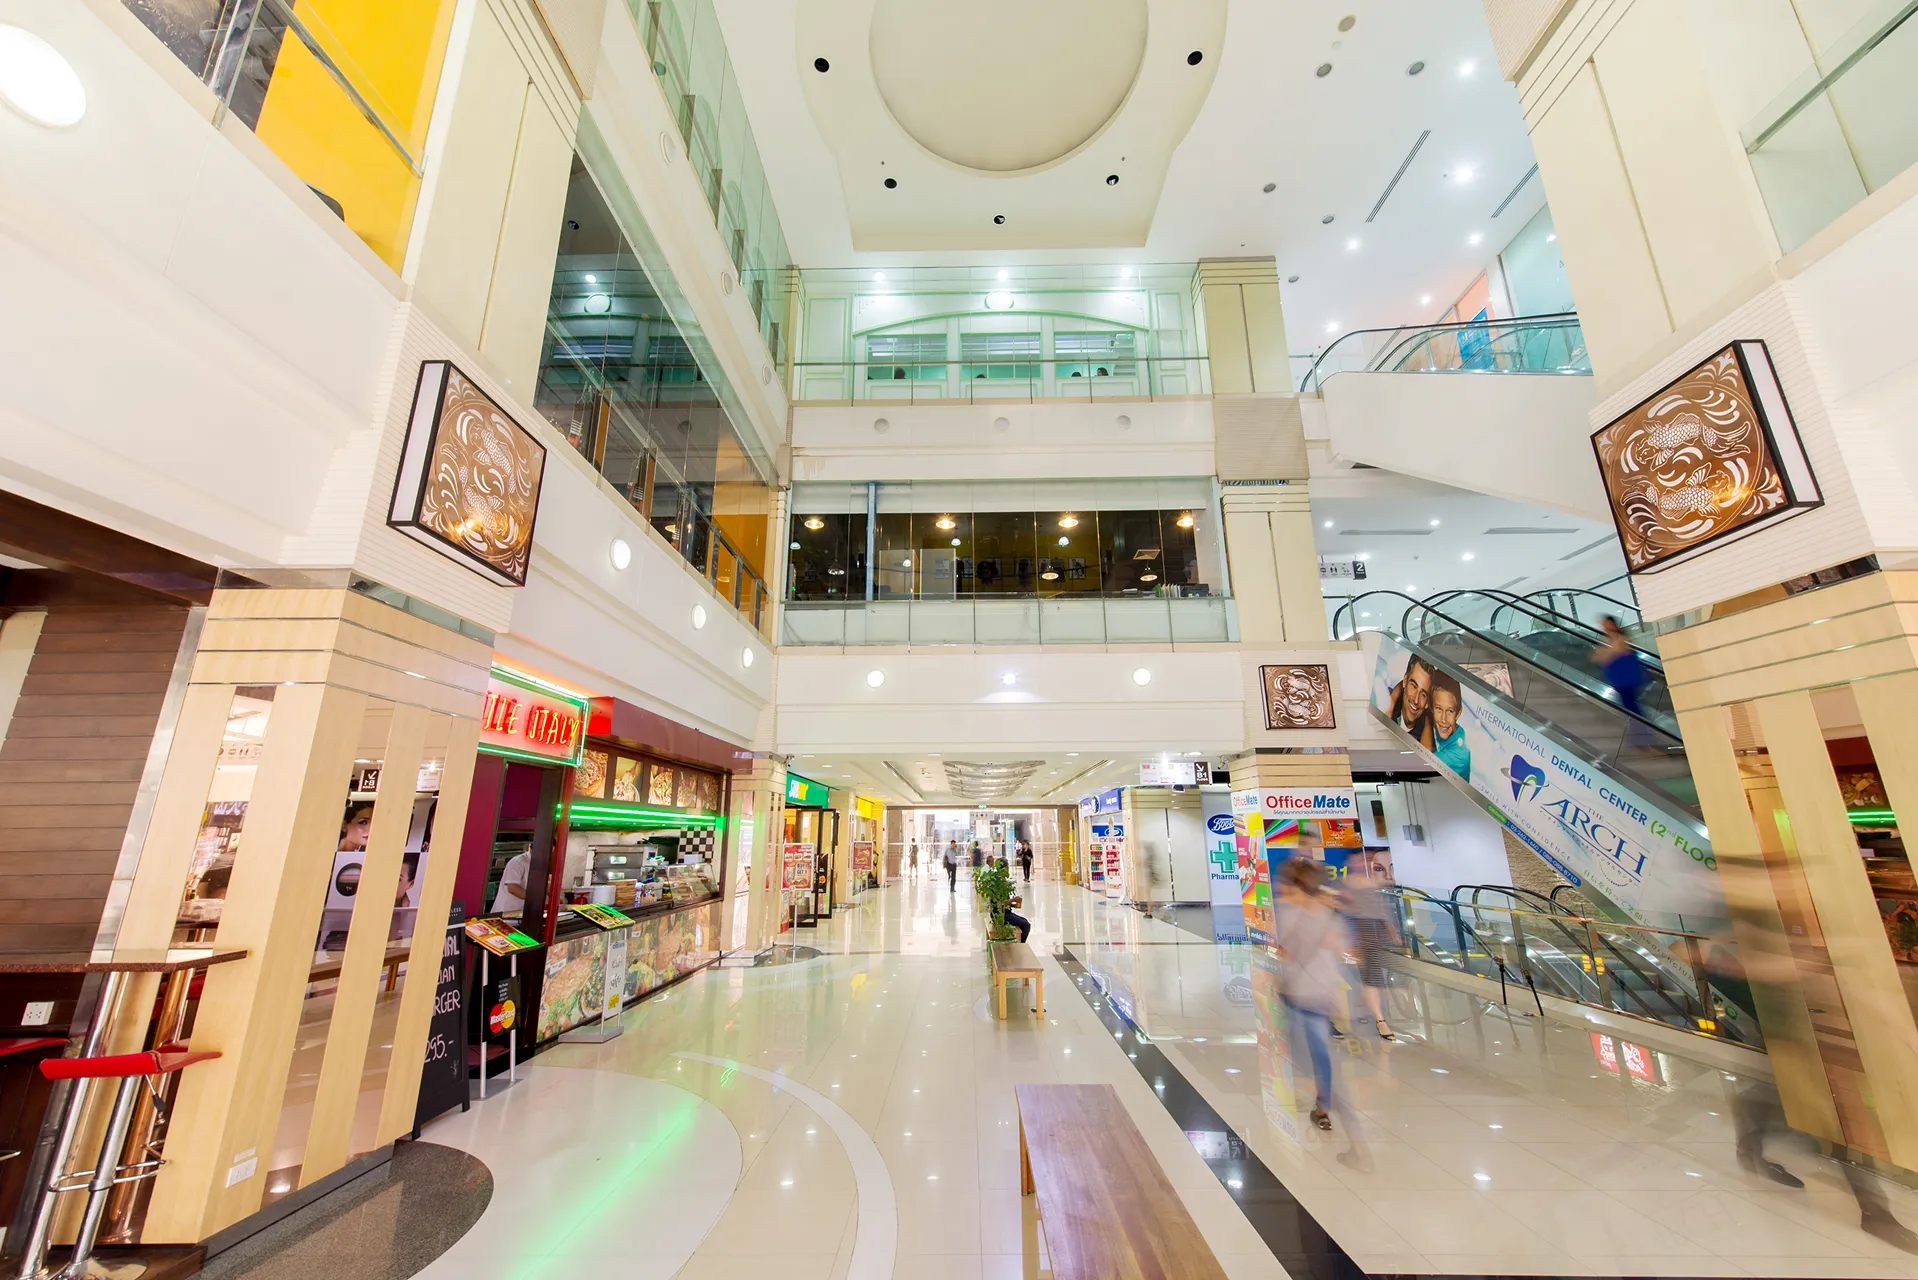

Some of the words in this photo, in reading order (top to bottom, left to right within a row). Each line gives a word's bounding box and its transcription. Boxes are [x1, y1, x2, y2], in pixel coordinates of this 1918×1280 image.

[1356, 563, 1364, 571] 2
[1476, 705, 1545, 758] INTERNATIONAL
[1551, 755, 1592, 789] DENTAL
[1599, 787, 1648, 825] CENTER
[1233, 795, 1258, 807] OfficeMate
[1265, 794, 1350, 808] OfficeMate
[1588, 807, 1604, 821] THE
[1521, 819, 1572, 861] CONFIDENCE
[1542, 798, 1649, 878] ARCH
[1211, 873, 1240, 881] Pharma
[438, 965, 455, 985] IAN
